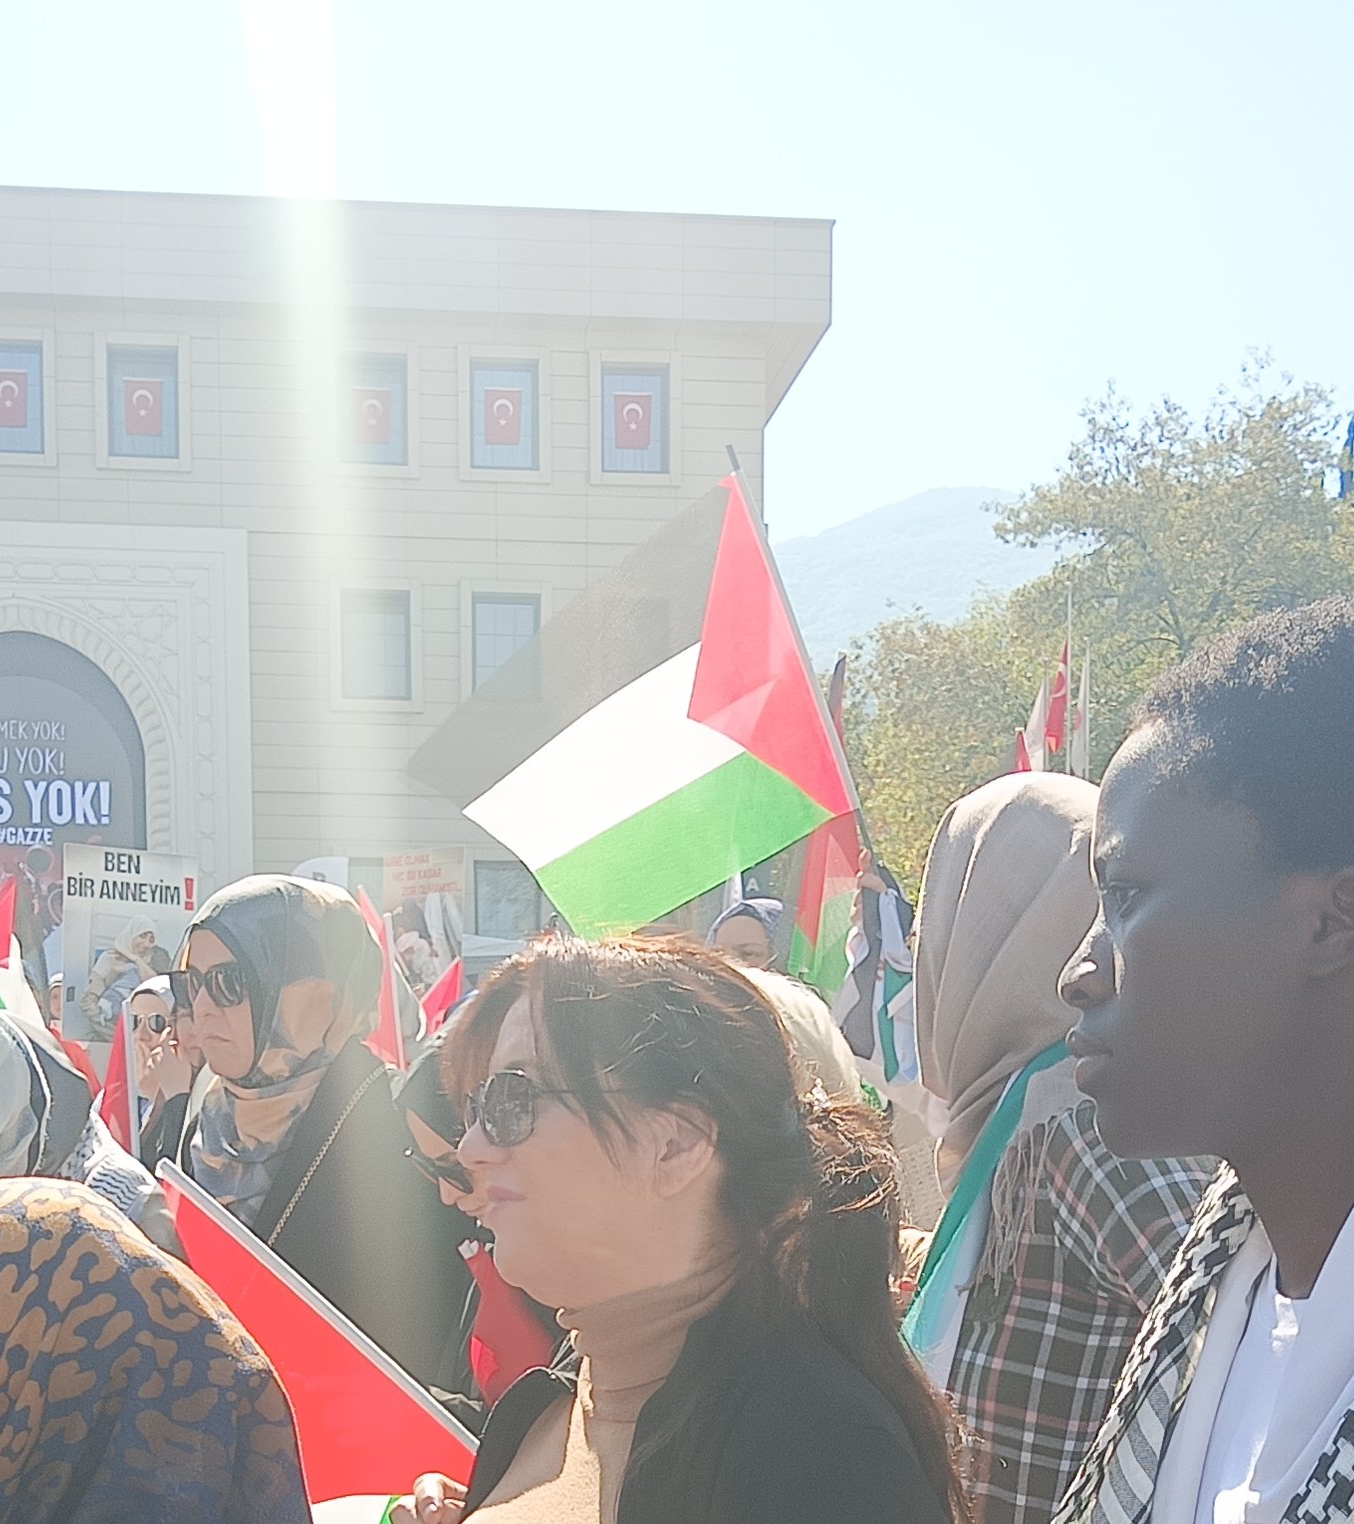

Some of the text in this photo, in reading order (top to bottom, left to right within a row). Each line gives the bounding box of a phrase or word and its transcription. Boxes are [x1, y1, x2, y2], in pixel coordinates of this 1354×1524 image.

[32, 720, 66, 741] YOK!
[15, 747, 65, 775] YOK!
[23, 779, 111, 825] YOK!
[104, 851, 141, 875] BEN
[67, 872, 95, 898] BİR
